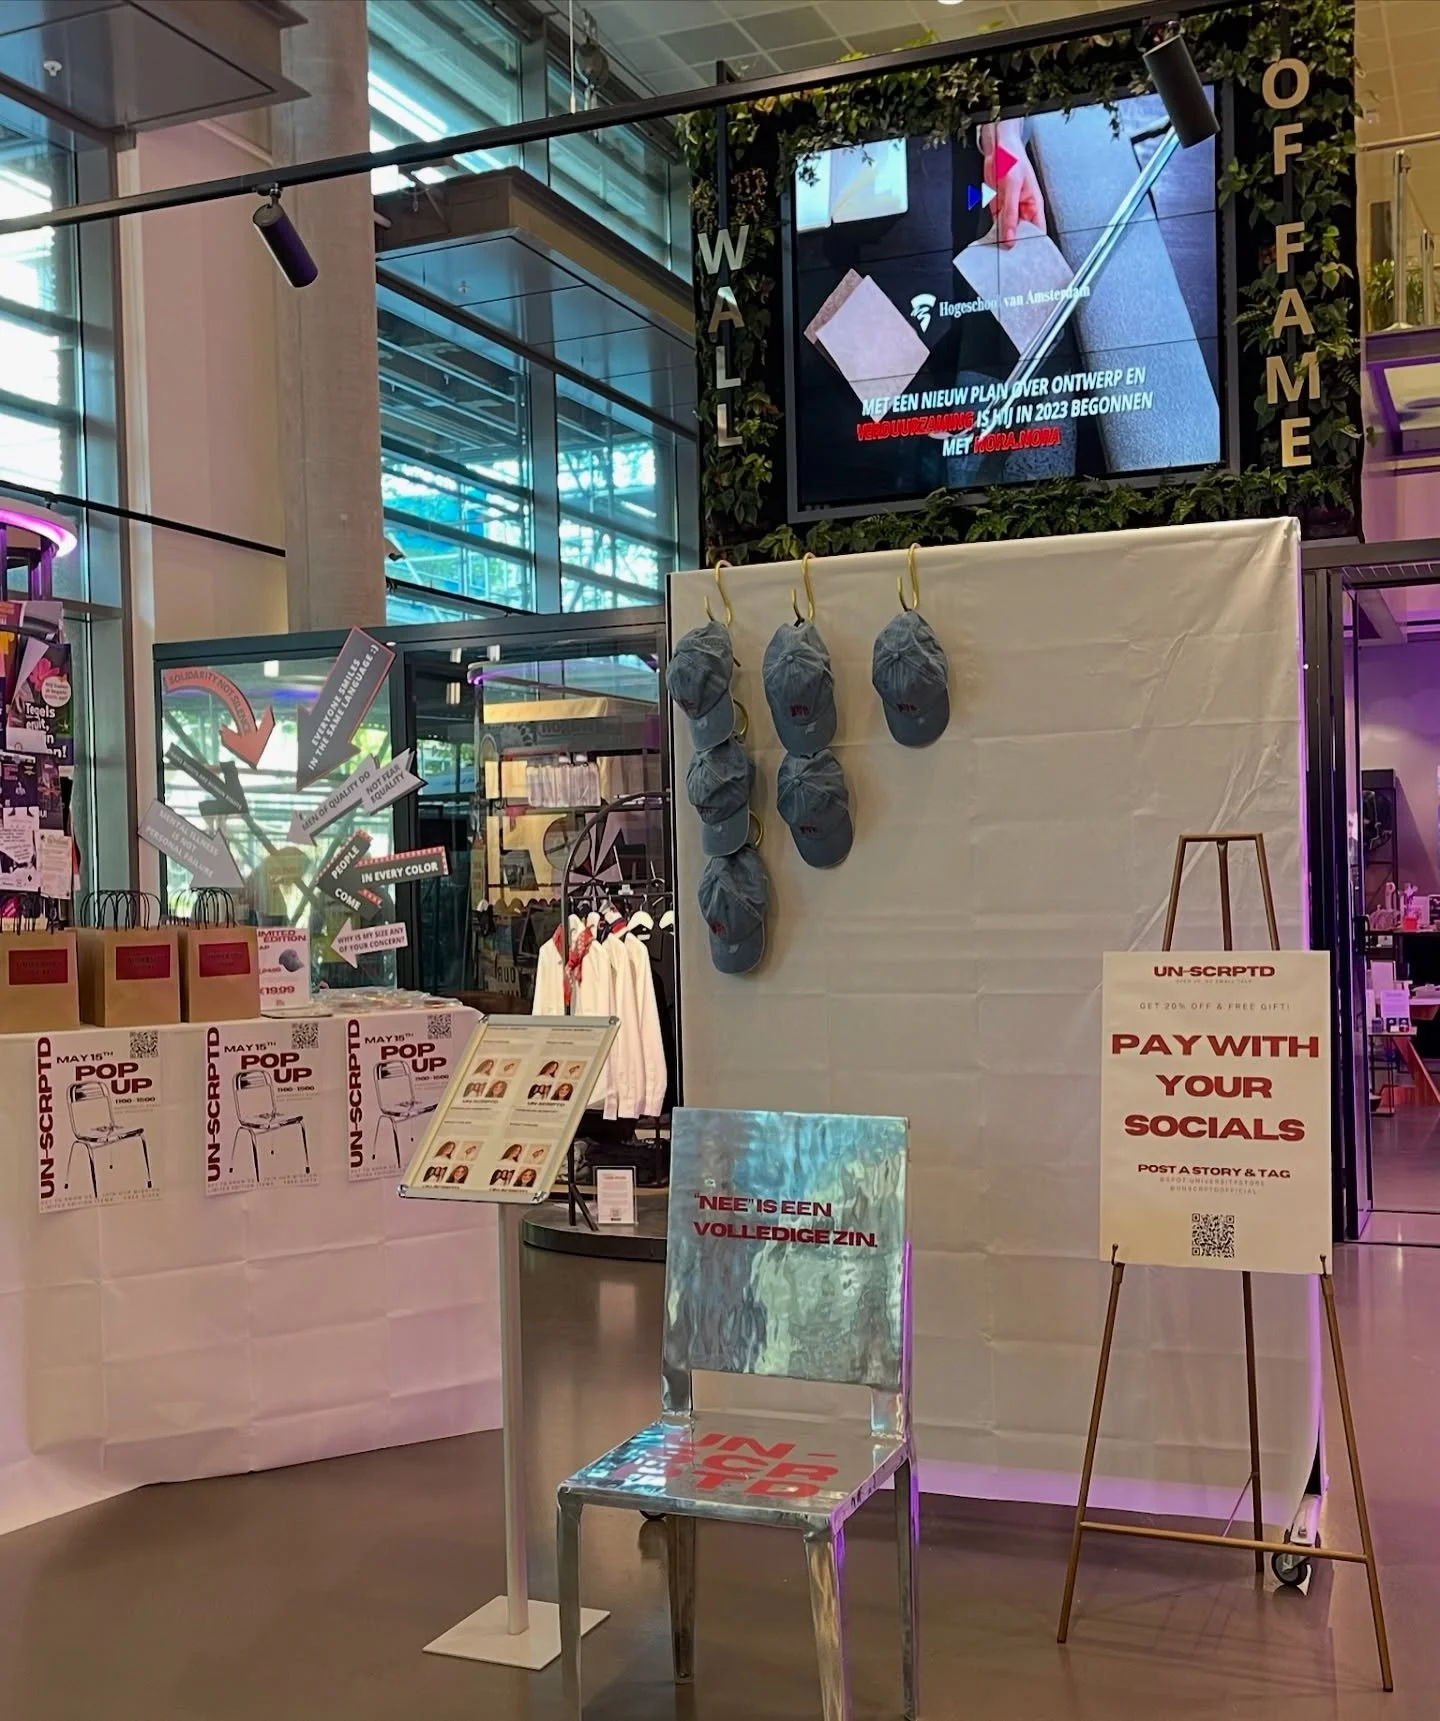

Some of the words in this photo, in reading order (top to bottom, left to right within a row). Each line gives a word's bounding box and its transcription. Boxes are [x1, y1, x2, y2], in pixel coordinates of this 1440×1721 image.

[1262, 57, 1311, 176] OF
[1003, 295, 1025, 308] van
[1025, 285, 1091, 306] Amsterdam
[697, 225, 750, 448] WALL
[1266, 221, 1321, 468] FAME
[862, 398, 885, 417] MET
[892, 394, 920, 414] EEN
[920, 389, 969, 410] NIEUW
[970, 384, 1010, 405] PLAN
[1011, 378, 1049, 399] OVER
[1051, 370, 1123, 394] ONTWERP
[1125, 366, 1147, 385] EN
[975, 409, 991, 429] IS
[1015, 405, 1034, 423] IN
[1035, 400, 1069, 421] 2023
[1070, 391, 1154, 418] BEGONNEN
[942, 437, 973, 457] MET
[169, 669, 217, 685] SOLIDARITY
[217, 679, 234, 697] NOT
[25, 702, 56, 720] Tegels
[308, 757, 319, 771] IN
[317, 737, 330, 757] THE
[326, 709, 346, 740] SAME
[342, 652, 374, 709] LANGUAGE
[311, 696, 343, 747] EVERYONE
[338, 658, 362, 696] SMILES
[365, 778, 382, 795] NOT
[381, 764, 401, 782] FEAR
[370, 773, 406, 804] EQUALITY
[301, 813, 319, 832] MEN
[319, 805, 329, 817] OF
[329, 779, 359, 809] QUALITY
[358, 770, 371, 784] DO
[180, 836, 198, 853] NOT
[331, 845, 360, 880] PEOPLE
[361, 872, 374, 884] IN
[374, 868, 403, 882] EVERY
[405, 861, 439, 876] COLOR
[334, 887, 361, 912] COME
[257, 930, 296, 938] IMITED
[264, 935, 306, 943] EDITION
[337, 934, 354, 944] WHY
[362, 931, 374, 940] MY
[375, 929, 389, 938] SIZE
[389, 927, 405, 937] ANY
[338, 945, 348, 953] OF
[349, 941, 368, 951] YOUR
[368, 936, 406, 949] CONCERN?
[1154, 966, 1276, 978] UN-SCRPTD
[1140, 1002, 1159, 1010] GET
[1165, 1002, 1186, 1010] 20%
[1191, 1002, 1211, 1010] OFF
[1228, 1003, 1254, 1011] FREE
[224, 1044, 253, 1053] MAY
[365, 1035, 393, 1045] MAY
[380, 1043, 436, 1060] POP
[1112, 1034, 1202, 1056] PAY
[1206, 1035, 1319, 1058] WITH
[56, 1053, 88, 1064] MAY
[241, 1053, 300, 1070] POP
[411, 1057, 447, 1073] UP
[75, 1062, 139, 1082] POP
[273, 1067, 312, 1083] UP
[111, 1078, 152, 1095] UP
[347, 1019, 363, 1169] UN-SCRPTD
[1155, 1074, 1273, 1098] YOUR
[207, 1027, 221, 1183] UN-SCRPTD
[37, 1036, 55, 1199] UN-SCRPTD
[1124, 1114, 1305, 1142] SOCIALS
[1138, 1164, 1177, 1174] POST
[1178, 1165, 1190, 1174] A
[1191, 1166, 1242, 1177] STORY
[1244, 1168, 1256, 1178] &
[1257, 1168, 1291, 1179] TAG
[756, 1199, 778, 1214] IS
[781, 1200, 832, 1217] EEN
[693, 1222, 830, 1245] VOLLEDIGE
[832, 1230, 878, 1248] ZIN.
